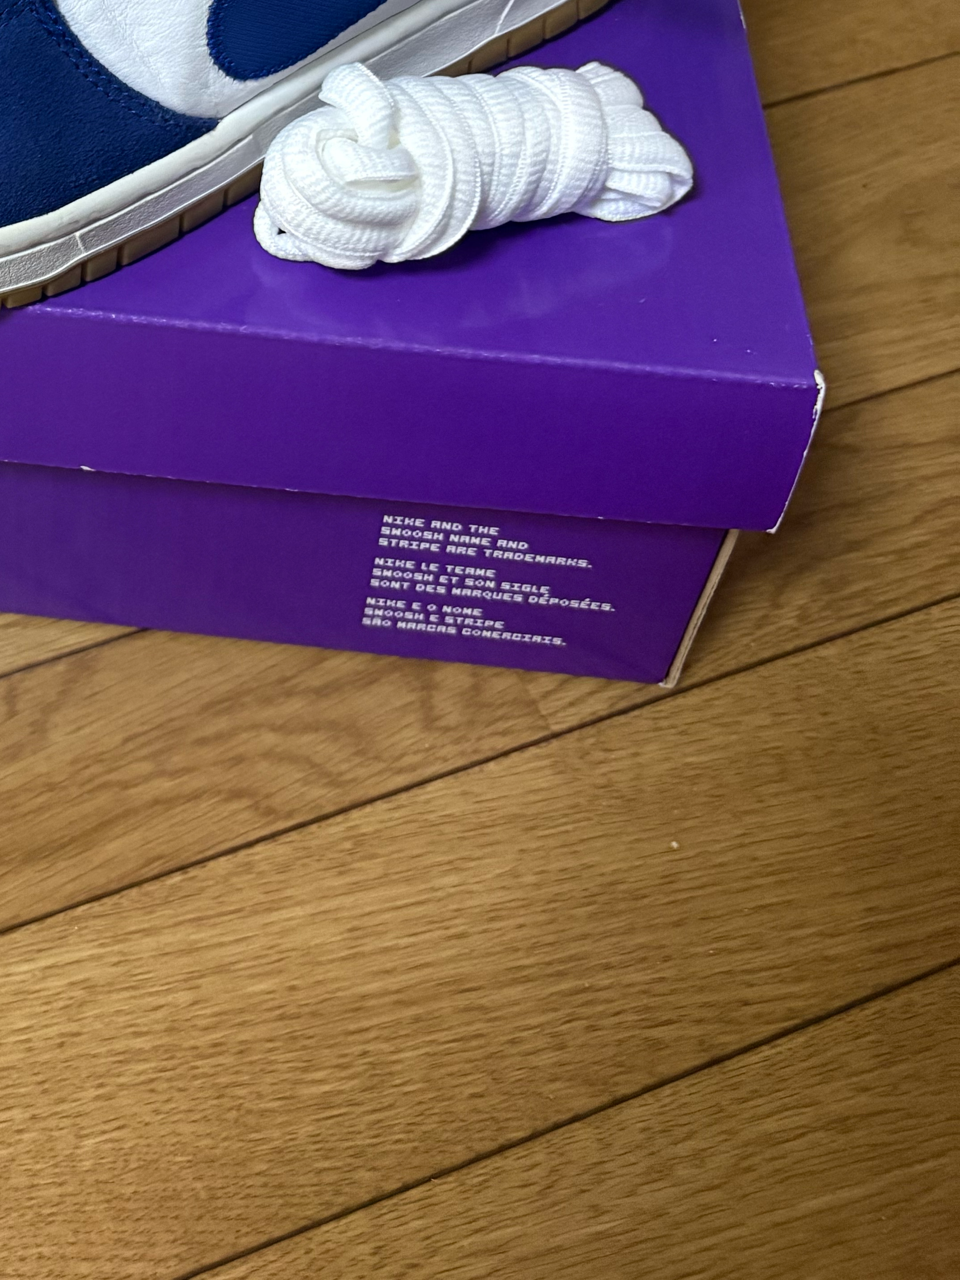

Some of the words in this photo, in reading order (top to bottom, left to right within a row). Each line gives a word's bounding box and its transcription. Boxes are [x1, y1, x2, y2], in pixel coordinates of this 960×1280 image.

[382, 514, 426, 528] NIKE
[430, 520, 463, 532] AND
[468, 524, 500, 536] THE
[380, 526, 444, 541] SWOOSH
[448, 533, 492, 546] NAME
[496, 539, 530, 551] AND
[374, 557, 416, 569] NIKE
[420, 562, 440, 572] LE
[378, 537, 441, 552] STRIPE
[445, 544, 478, 556] ARE
[483, 548, 593, 568] TRADEMARKS.
[370, 578, 411, 589] SONT
[415, 583, 446, 594] DES
[451, 587, 524, 603] MARQUES
[371, 567, 434, 582] SWOOSH
[438, 575, 460, 585] ET
[464, 577, 496, 589] SON
[500, 581, 551, 595] SIGLE
[364, 607, 424, 621] SWOOSH
[429, 614, 440, 623] E
[444, 615, 505, 630] STRIPE
[365, 596, 406, 609] NIKE
[411, 602, 422, 610] E
[441, 605, 483, 617] NOME
